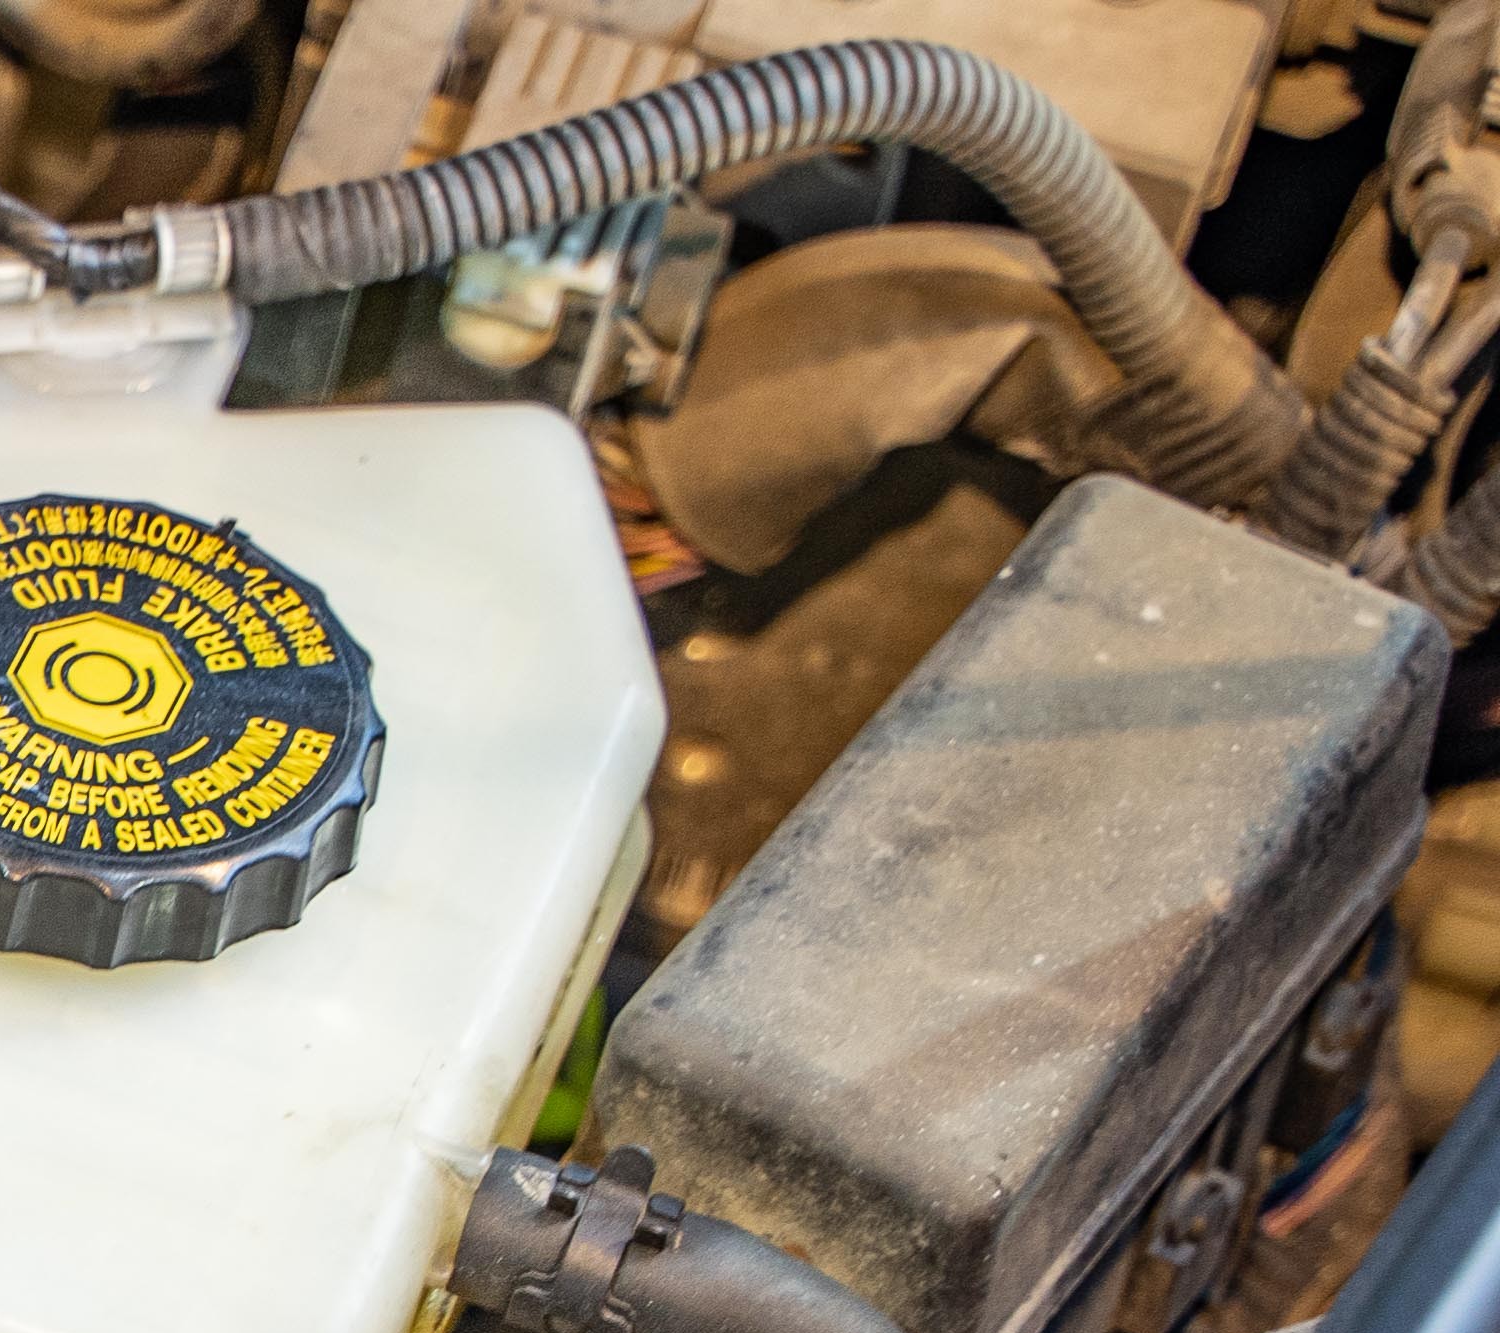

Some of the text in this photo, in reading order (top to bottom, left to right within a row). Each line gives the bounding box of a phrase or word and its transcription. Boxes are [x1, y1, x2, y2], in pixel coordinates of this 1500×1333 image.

[12, 570, 249, 673] BRAKE FLUID
[45, 780, 168, 819] BEFORE
[172, 716, 289, 809] REMOVING
[80, 818, 103, 850] A
[115, 808, 226, 853] SEALED
[225, 727, 337, 827] CONTAINER
